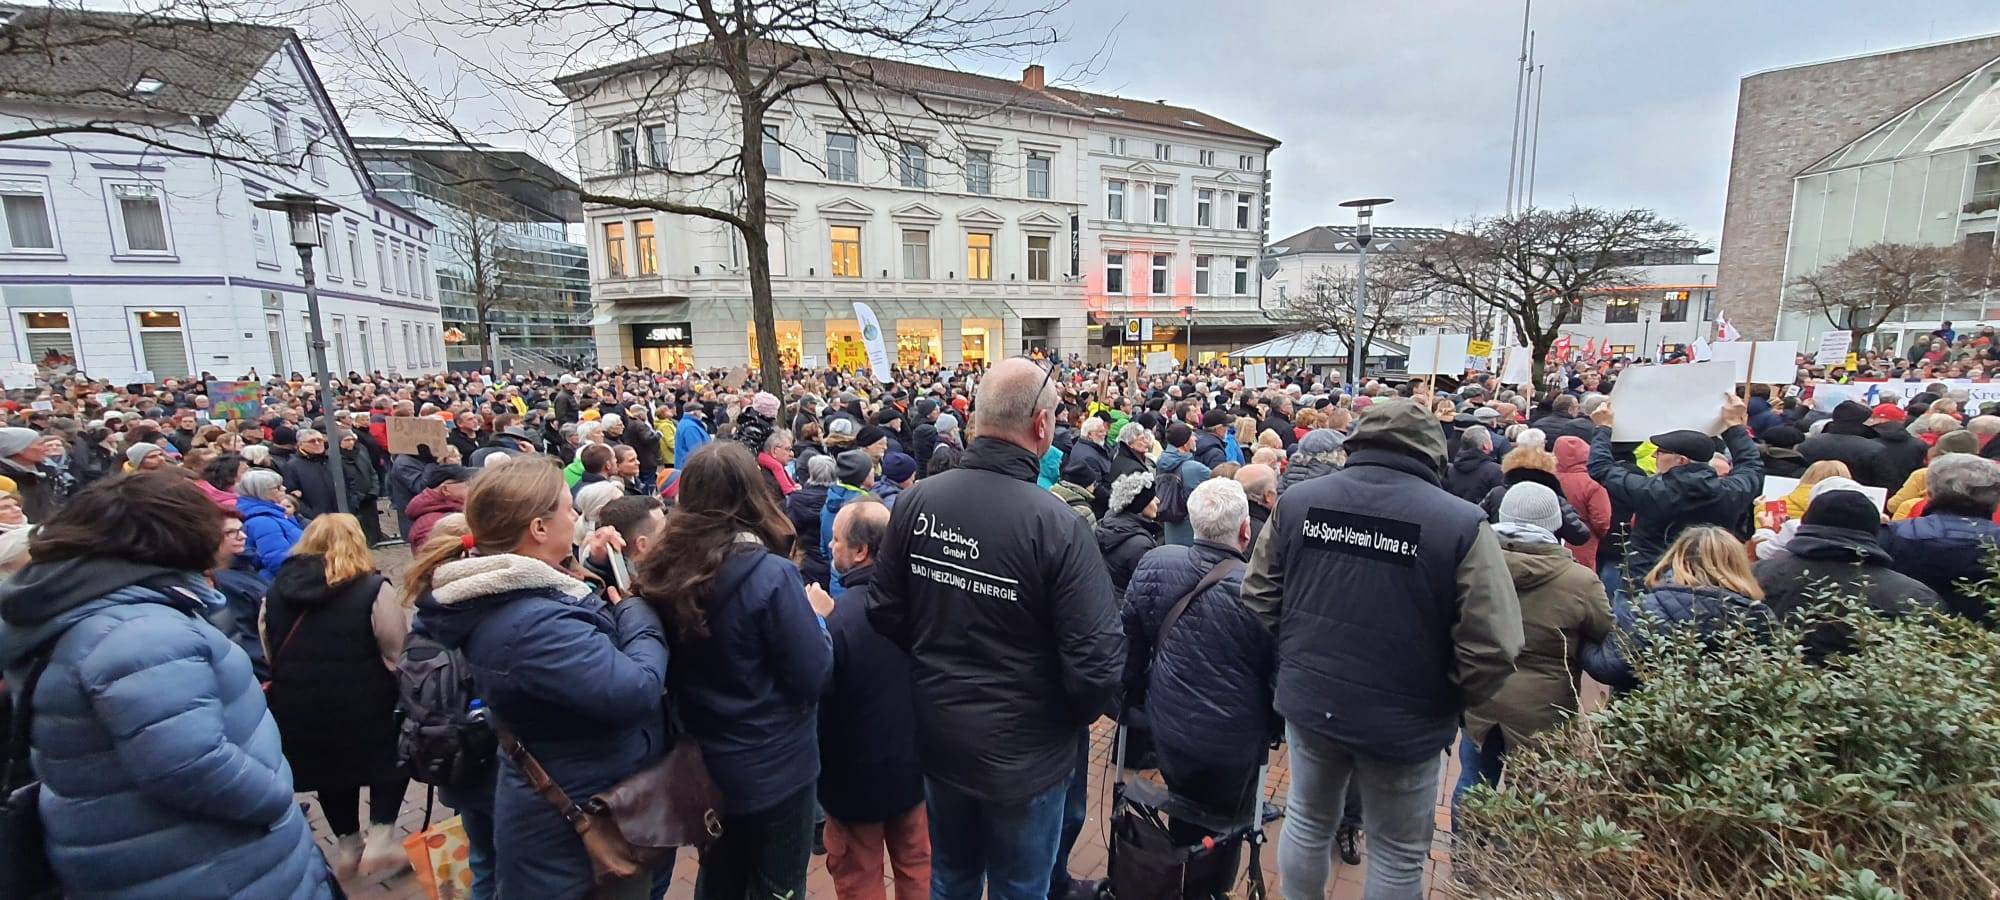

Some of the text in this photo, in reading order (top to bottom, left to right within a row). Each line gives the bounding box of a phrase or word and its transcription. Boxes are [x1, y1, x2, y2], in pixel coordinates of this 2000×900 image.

[652, 327, 682, 340] SINN
[930, 513, 980, 559] Liebing
[943, 545, 966, 560] GmbH
[1302, 519, 1372, 548] Rad-Sport-Verein
[1373, 531, 1399, 553] Unna
[911, 563, 926, 577] BAD
[931, 569, 966, 590] HEIZUNG
[973, 581, 1018, 601] ENERGIE
